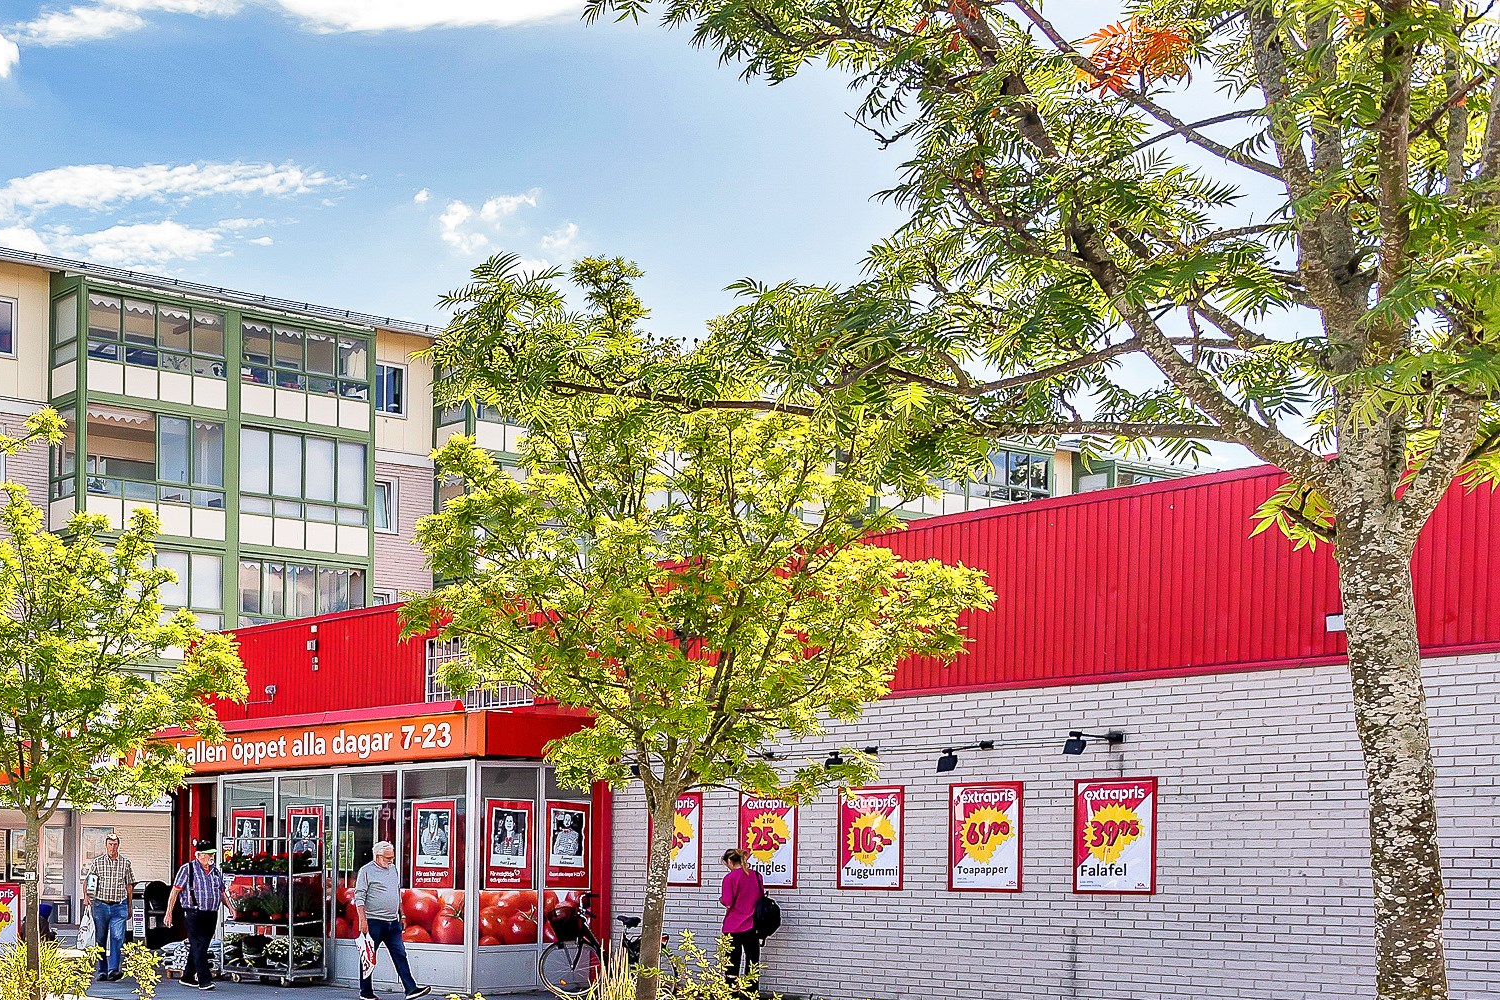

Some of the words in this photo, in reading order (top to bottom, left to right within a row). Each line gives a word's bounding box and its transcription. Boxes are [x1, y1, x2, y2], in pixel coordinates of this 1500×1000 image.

[231, 736, 286, 765] öppet
[292, 731, 325, 757] alla
[332, 727, 393, 759] dagar
[400, 722, 452, 750] 7-23
[847, 793, 898, 812] extrapris
[960, 789, 1016, 806] extrapris
[1083, 785, 1145, 803] extrapris
[844, 866, 898, 879] Tuggummi
[956, 865, 1008, 877] Toapapper
[1080, 863, 1127, 877] Falafel
